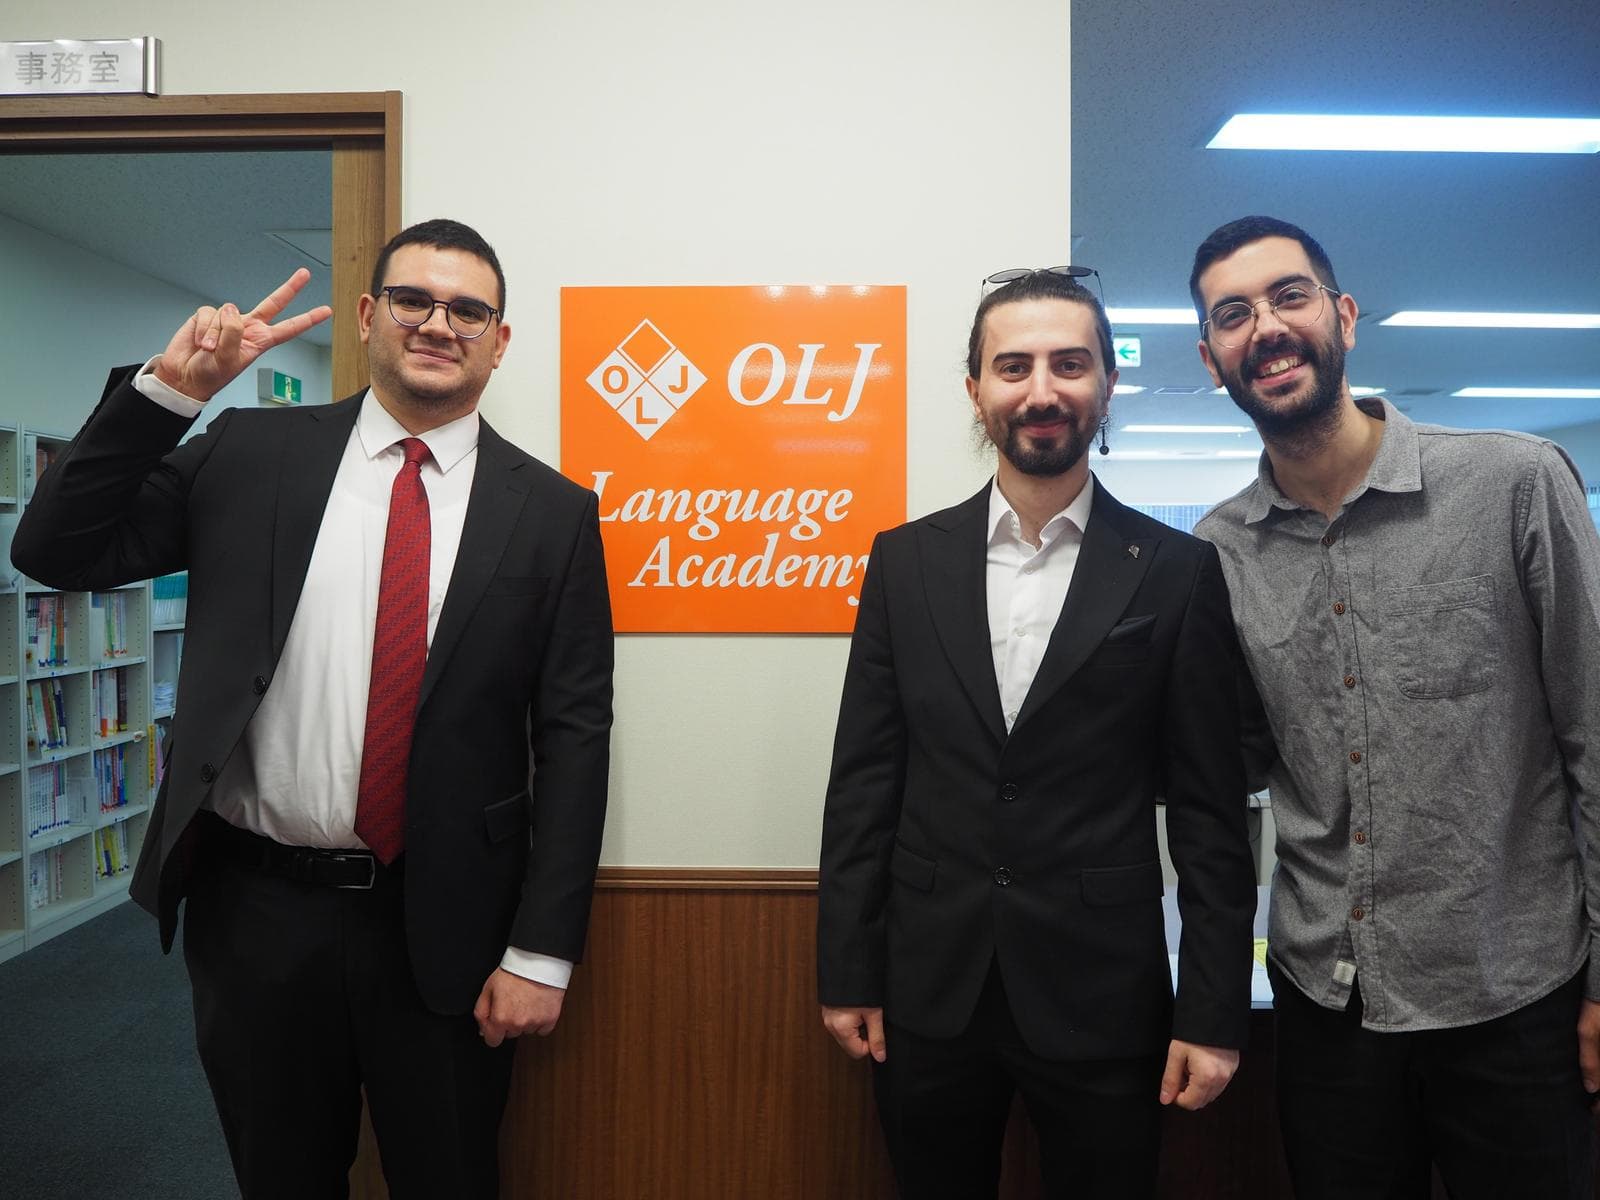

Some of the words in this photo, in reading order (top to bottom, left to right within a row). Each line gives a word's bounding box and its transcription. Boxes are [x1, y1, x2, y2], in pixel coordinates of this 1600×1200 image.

[15, 51, 119, 85] 事務室
[602, 365, 629, 394] O
[636, 396, 658, 425] L
[668, 365, 688, 394] J
[727, 342, 882, 422] OLJ
[591, 471, 853, 541] Language
